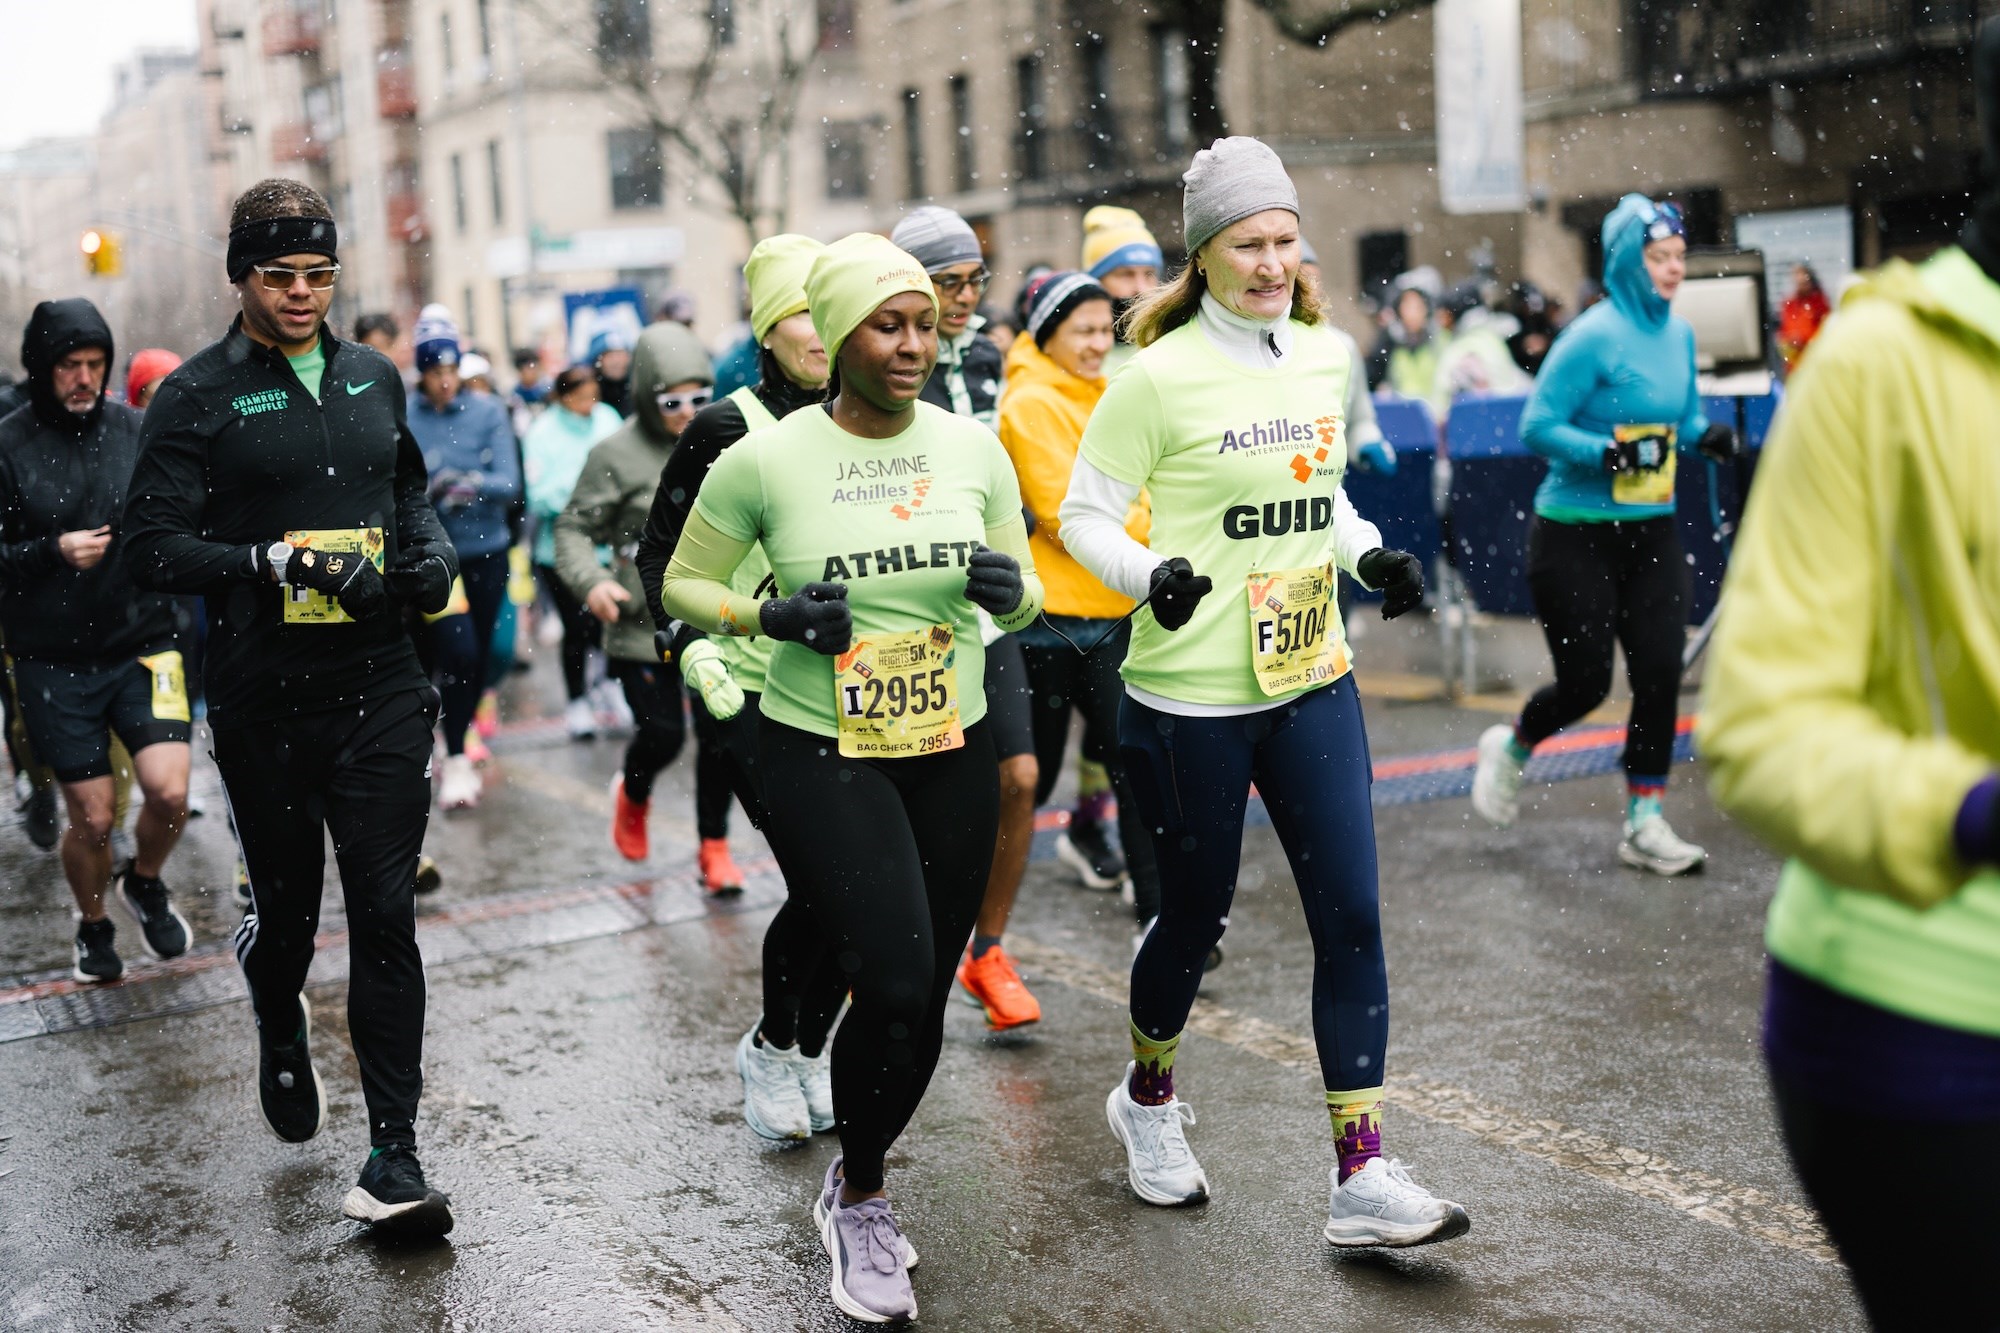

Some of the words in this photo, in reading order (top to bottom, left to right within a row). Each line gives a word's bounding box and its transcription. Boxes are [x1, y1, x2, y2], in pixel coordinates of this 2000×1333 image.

[232, 391, 288, 410] SHAMROCK
[1218, 418, 1314, 454] Achilles
[1245, 443, 1316, 458] INTERNATIONAL
[836, 455, 930, 480] JASMINE
[1316, 466, 1335, 477] New
[831, 483, 908, 504] Achilles
[850, 497, 909, 507] INTERNATIONAL
[914, 509, 932, 517] New
[1223, 494, 1334, 540] GUID
[1288, 588, 1312, 601] HEIGHTS
[1312, 578, 1323, 596] 5K
[878, 652, 910, 666] HEIGHTS
[909, 643, 927, 661] 5K
[1268, 678, 1281, 690] BAG
[1281, 673, 1302, 686] CHECK
[1305, 663, 1336, 684] 5104
[880, 743, 913, 751] CHECK
[919, 733, 951, 752] 2955
